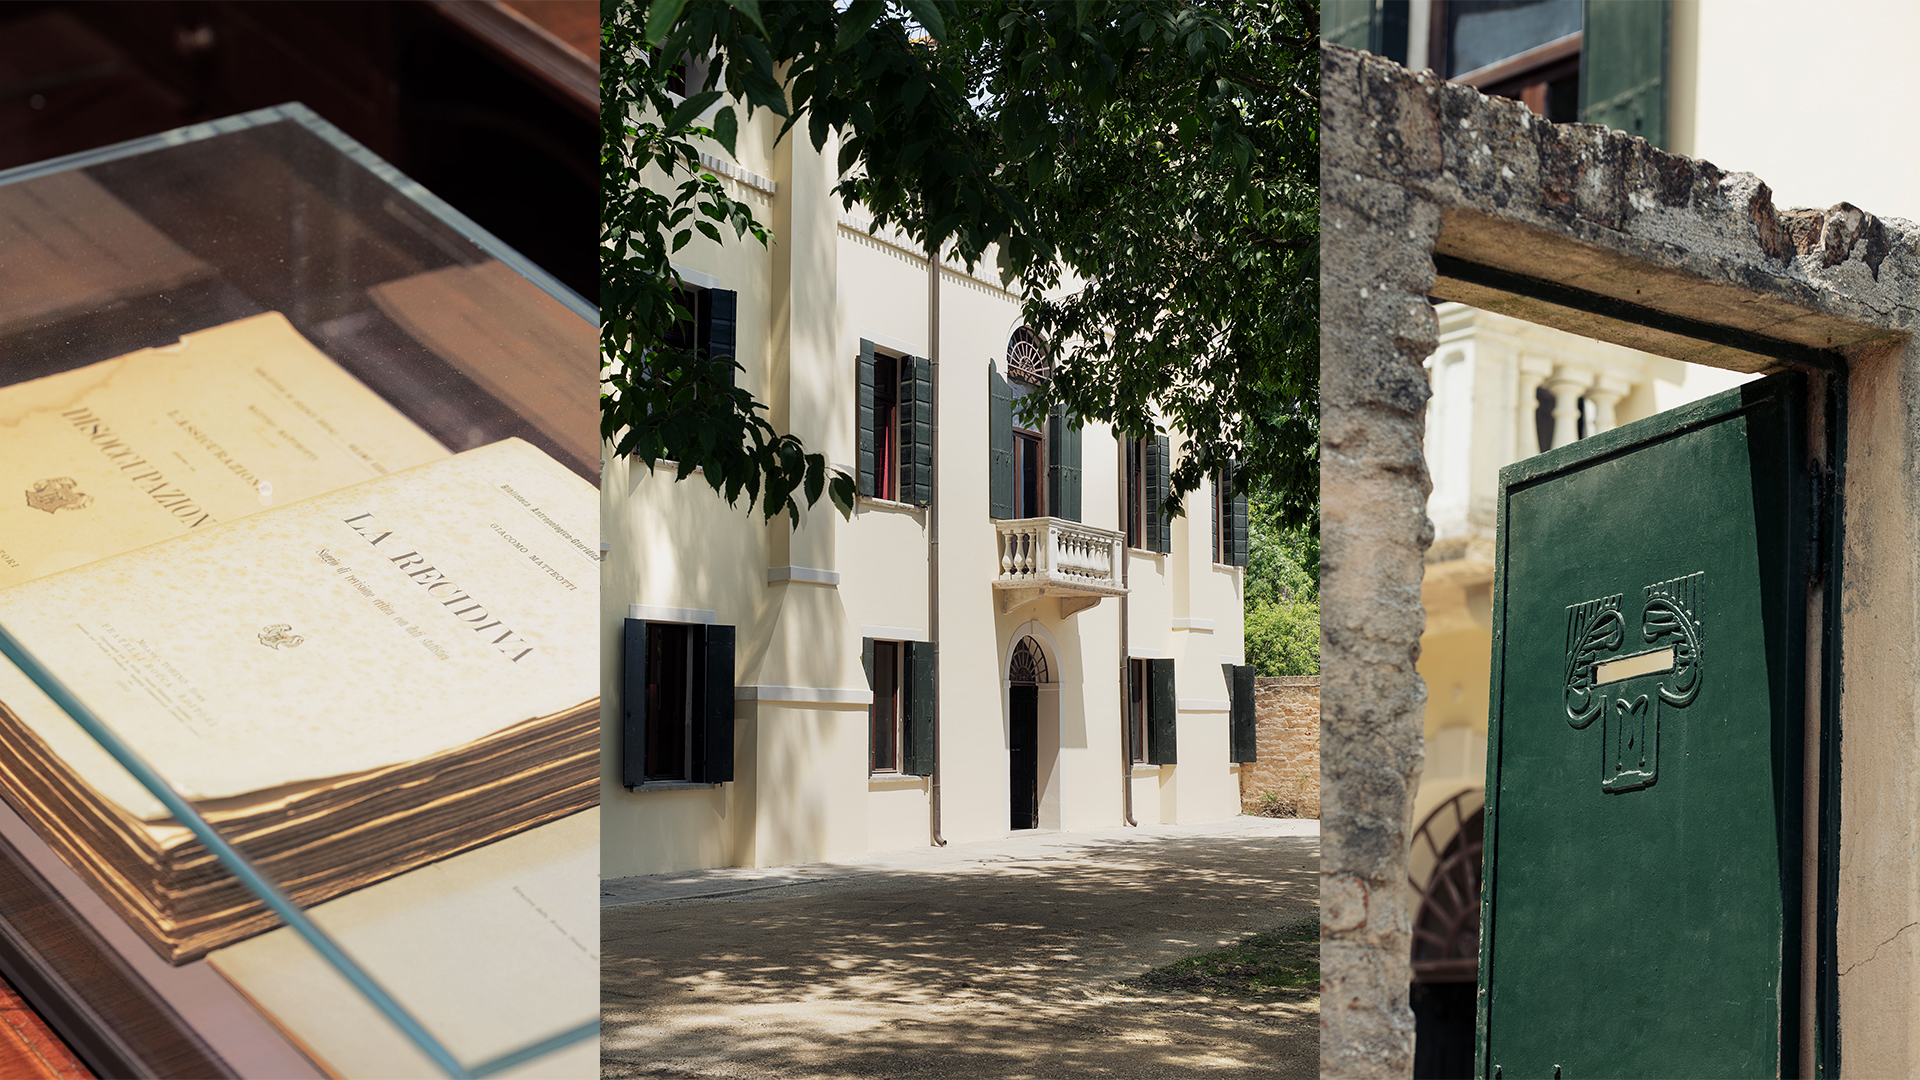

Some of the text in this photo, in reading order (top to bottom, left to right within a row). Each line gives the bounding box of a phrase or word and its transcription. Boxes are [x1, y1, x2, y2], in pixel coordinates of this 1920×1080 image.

[500, 484, 531, 507] Biblioteca
[341, 511, 534, 664] LA RECIDIVA
[490, 523, 578, 591] GIACOMO MATTEOTTI
